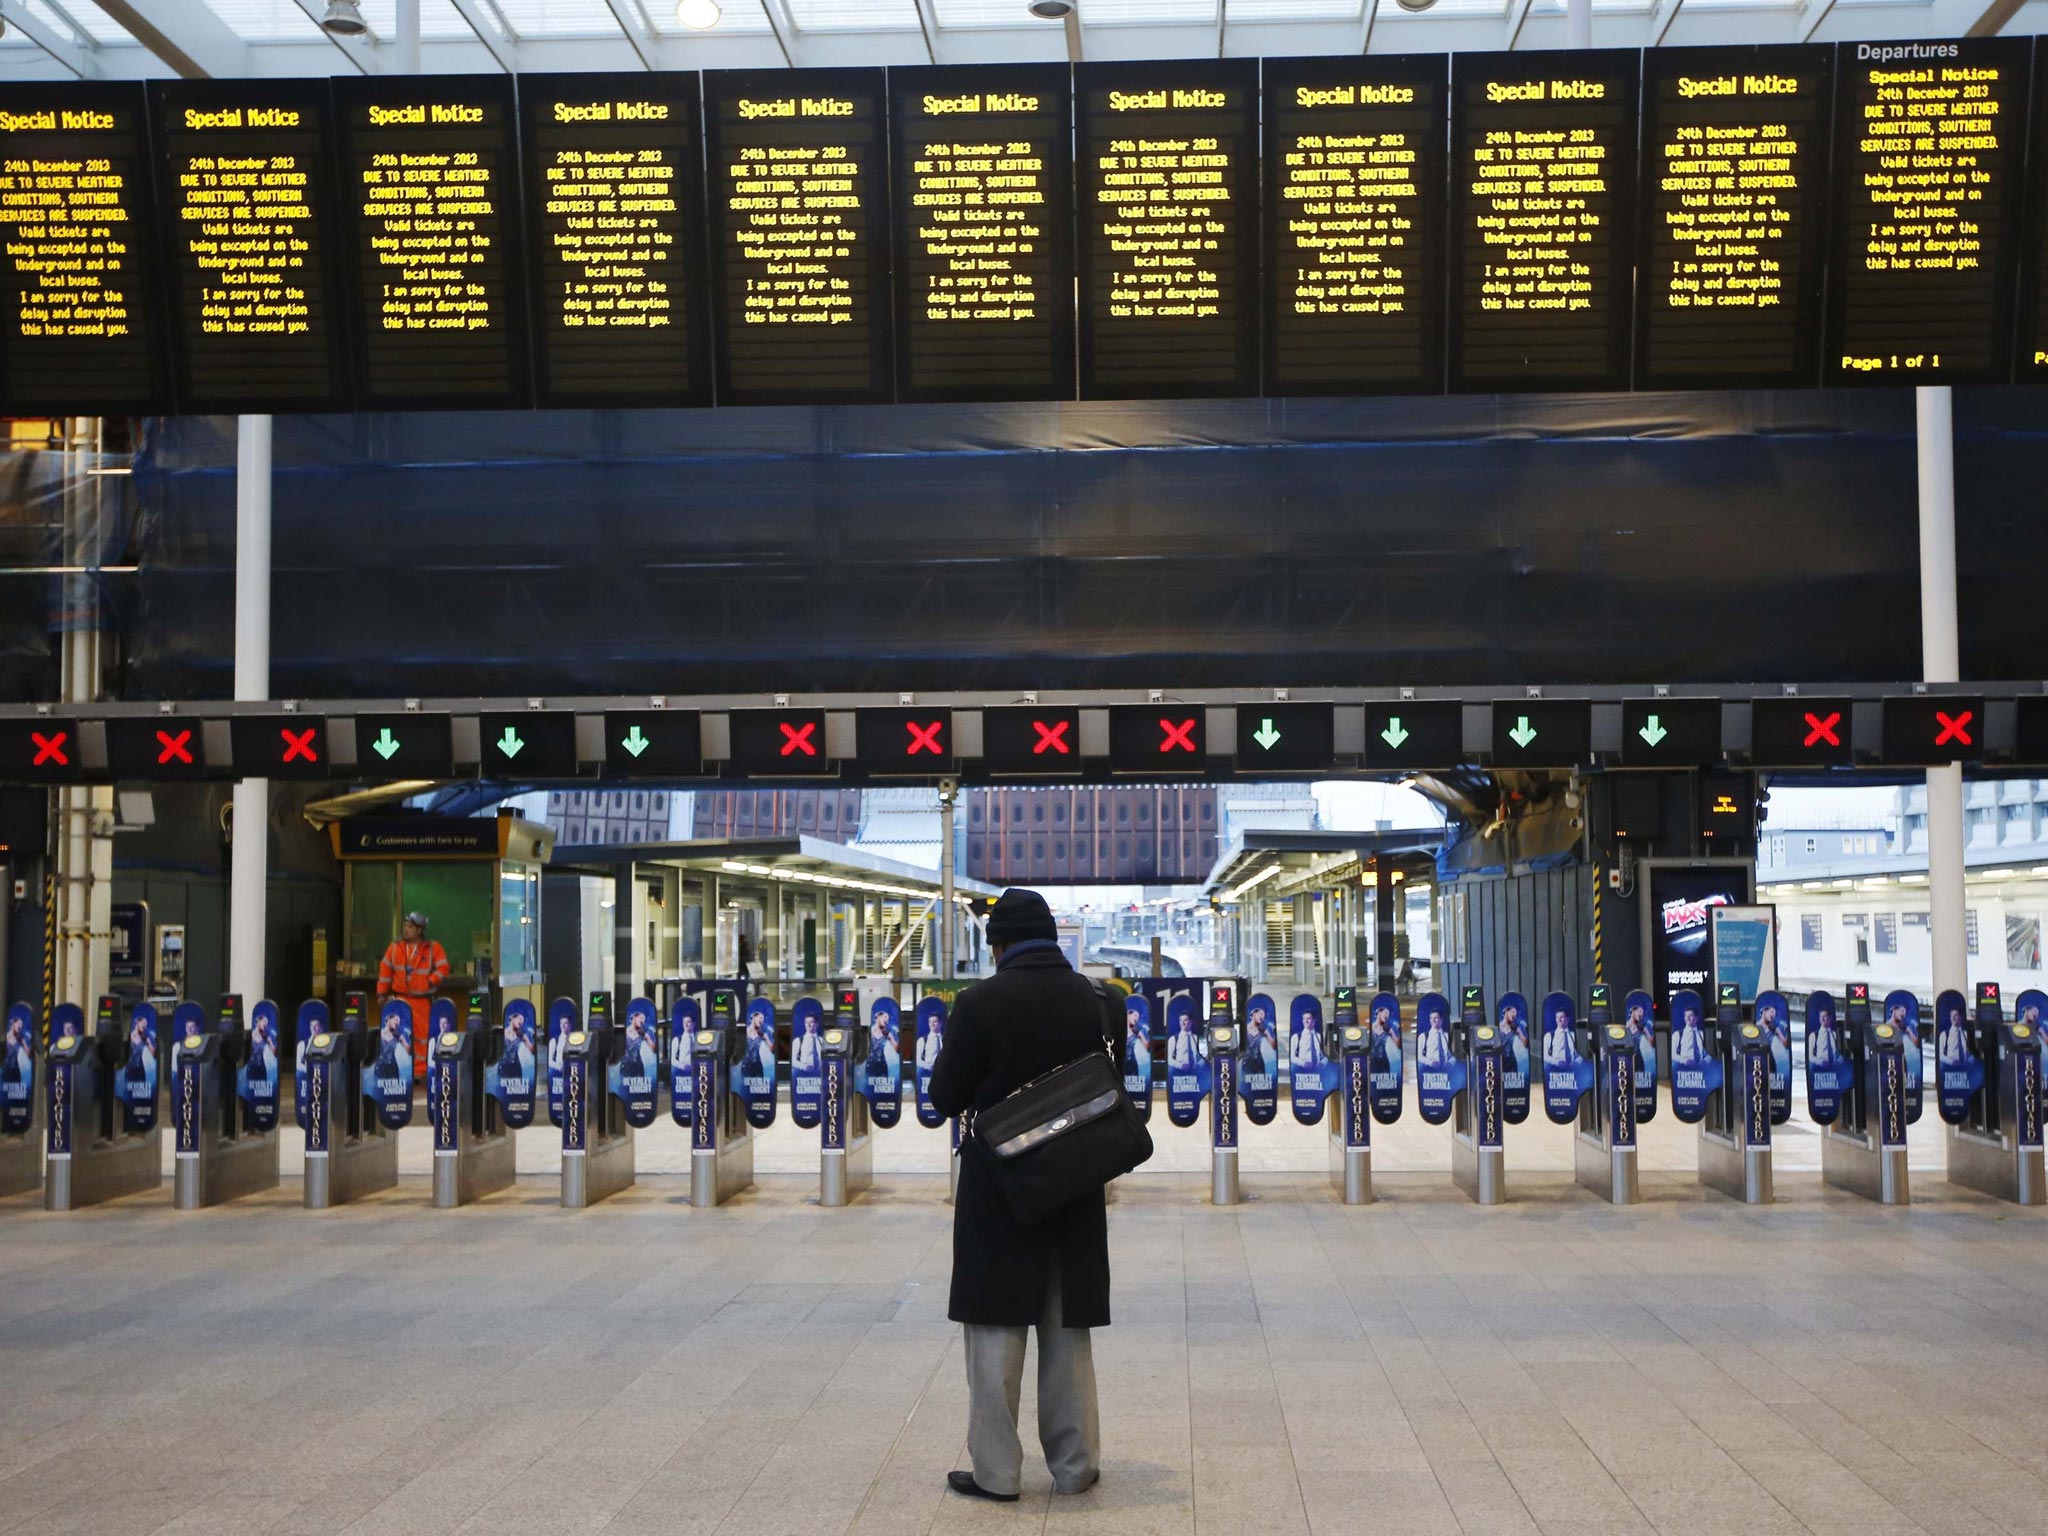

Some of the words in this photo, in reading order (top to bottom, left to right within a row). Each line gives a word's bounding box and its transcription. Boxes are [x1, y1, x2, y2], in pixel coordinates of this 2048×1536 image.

[1857, 43, 1959, 63] Departures
[1869, 69, 1934, 85] Special
[1942, 68, 1998, 81] Notice
[1487, 81, 1545, 101] Special
[1551, 80, 1604, 98] Notice
[1678, 76, 1737, 97] Special
[1743, 75, 1797, 94] Notice
[1877, 88, 1903, 100] 24th
[1907, 86, 1959, 99] December
[1963, 85, 1989, 98] 2013
[1110, 91, 1167, 110] Special
[1173, 90, 1225, 107] Notice
[1297, 87, 1354, 106] Special
[1361, 86, 1413, 103] Notice
[554, 103, 611, 121] Special
[617, 102, 668, 119] Notice
[739, 100, 795, 118] Special
[801, 99, 853, 115] Notice
[923, 96, 980, 114] Special
[986, 95, 1038, 111] Notice
[1865, 105, 1885, 118] DUE
[1889, 105, 1903, 117] TO
[1907, 103, 1947, 116] SEVERE
[1951, 101, 1999, 115] WEATHER
[0, 112, 56, 131] Special
[61, 111, 114, 129] Notice
[185, 109, 242, 127] Special
[247, 109, 299, 126] Notice
[369, 106, 425, 124] Special
[431, 105, 483, 122] Notice
[1869, 120, 1934, 135] CONDITIONS,
[1939, 119, 1991, 133] SOUTHERN
[1860, 138, 1911, 152] SERVICES
[1915, 138, 1935, 150] ARE
[1939, 136, 1998, 150] SUSPENDED.
[190, 158, 215, 170] 24th
[218, 158, 267, 169] December
[271, 157, 294, 169] 2013
[1881, 156, 1908, 168] Valid
[1912, 155, 1953, 167] tickets
[1957, 156, 1976, 166] are
[180, 174, 200, 186] DUE
[203, 174, 217, 186] TO
[220, 174, 258, 186] SEVERE
[261, 173, 306, 185] WEATHER
[1865, 173, 1893, 187] being
[1953, 174, 1966, 183] on
[1971, 171, 1990, 183] the
[187, 190, 249, 203] CONDITIONS,
[252, 190, 302, 202] SOUTHERN
[1871, 189, 1941, 203] Underground
[1944, 188, 1964, 200] and
[1968, 190, 1981, 200] on
[181, 207, 230, 219] SERVICES
[233, 206, 252, 218] ARE
[255, 206, 311, 218] SUSPENDED.
[1894, 206, 1920, 218] local
[1924, 206, 1958, 218] buses.
[202, 224, 229, 235] Valid
[232, 224, 271, 235] tickets
[274, 225, 293, 234] are
[1871, 224, 1877, 236] I
[1899, 225, 1931, 237] sorry
[1935, 223, 1954, 234] for
[1959, 222, 1978, 233] the
[190, 241, 218, 253] being
[273, 241, 286, 251] on
[289, 239, 308, 250] the
[1867, 241, 1897, 254] delay
[1901, 240, 1920, 252] and
[1924, 238, 1980, 252] disruption
[198, 256, 264, 269] Underground
[268, 256, 286, 267] and
[290, 257, 302, 266] on
[1866, 258, 1887, 269] this
[1891, 258, 1911, 268] has
[1915, 256, 1953, 268] caused
[1957, 258, 1978, 269] you.
[222, 272, 247, 284] local
[250, 272, 282, 283] buses.
[203, 288, 209, 300] I
[230, 290, 260, 301] sorry
[263, 288, 282, 299] for
[285, 288, 304, 299] the
[202, 305, 230, 317] delay
[234, 304, 252, 316] and
[255, 304, 308, 316] disruption
[202, 321, 223, 332] this
[226, 321, 245, 332] has
[249, 320, 285, 332] caused
[288, 322, 308, 332] you.
[1842, 356, 1882, 371] Page
[1891, 355, 1898, 368] 1
[1905, 355, 1924, 368] of
[1932, 354, 1939, 367] 1
[376, 835, 417, 845] Customers
[419, 835, 436, 845] with
[438, 835, 453, 845] fare
[454, 836, 463, 845] to
[464, 837, 478, 846] pay
[1173, 1076, 1197, 1084] TRISTAN
[1296, 1074, 1320, 1082] TRISTAN
[1423, 1073, 1448, 1082] TRISTAN
[1549, 1073, 1574, 1082] TRISTAN
[1677, 1072, 1703, 1080] TRISTAN
[1944, 1072, 1967, 1080] TRISTAN
[312, 1068, 322, 1145] BODYGUARD
[440, 1067, 450, 1145] BODYGUARD
[568, 1066, 579, 1144] BODYGUARD
[698, 1066, 708, 1144] BODYGUARD
[827, 1065, 838, 1143] BODYGUARD
[1220, 1063, 1231, 1141] BODYGUARD
[1352, 1061, 1363, 1140] BODYGUARD
[1485, 1061, 1495, 1140] BODYGUARD
[1617, 1060, 1628, 1139] BODYGUARD
[1753, 1060, 1763, 1139] BODYGUARD
[1887, 1059, 1899, 1139] BODYGUARD
[2025, 1059, 2036, 1139] BODYGUARD
[54, 1069, 64, 1148] BODYGUARD
[183, 1069, 193, 1147] BODYGUARD
